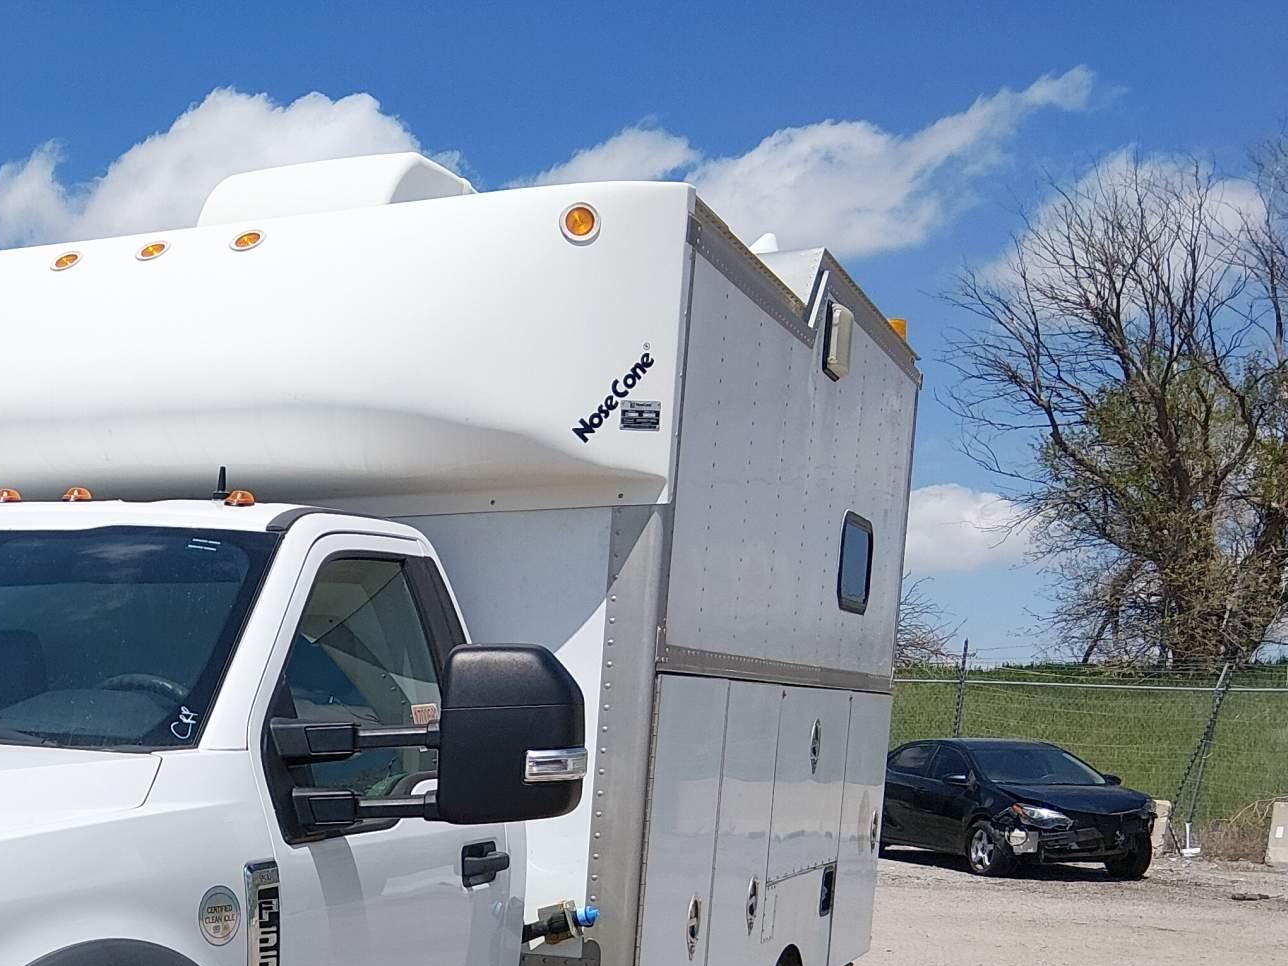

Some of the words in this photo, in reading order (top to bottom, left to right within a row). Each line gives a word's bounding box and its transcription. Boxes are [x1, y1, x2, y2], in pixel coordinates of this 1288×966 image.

[572, 352, 654, 443] NoseCone
[207, 904, 233, 915] CERTIFIED
[205, 915, 223, 924] CLEAN
[224, 913, 235, 922] IDLE
